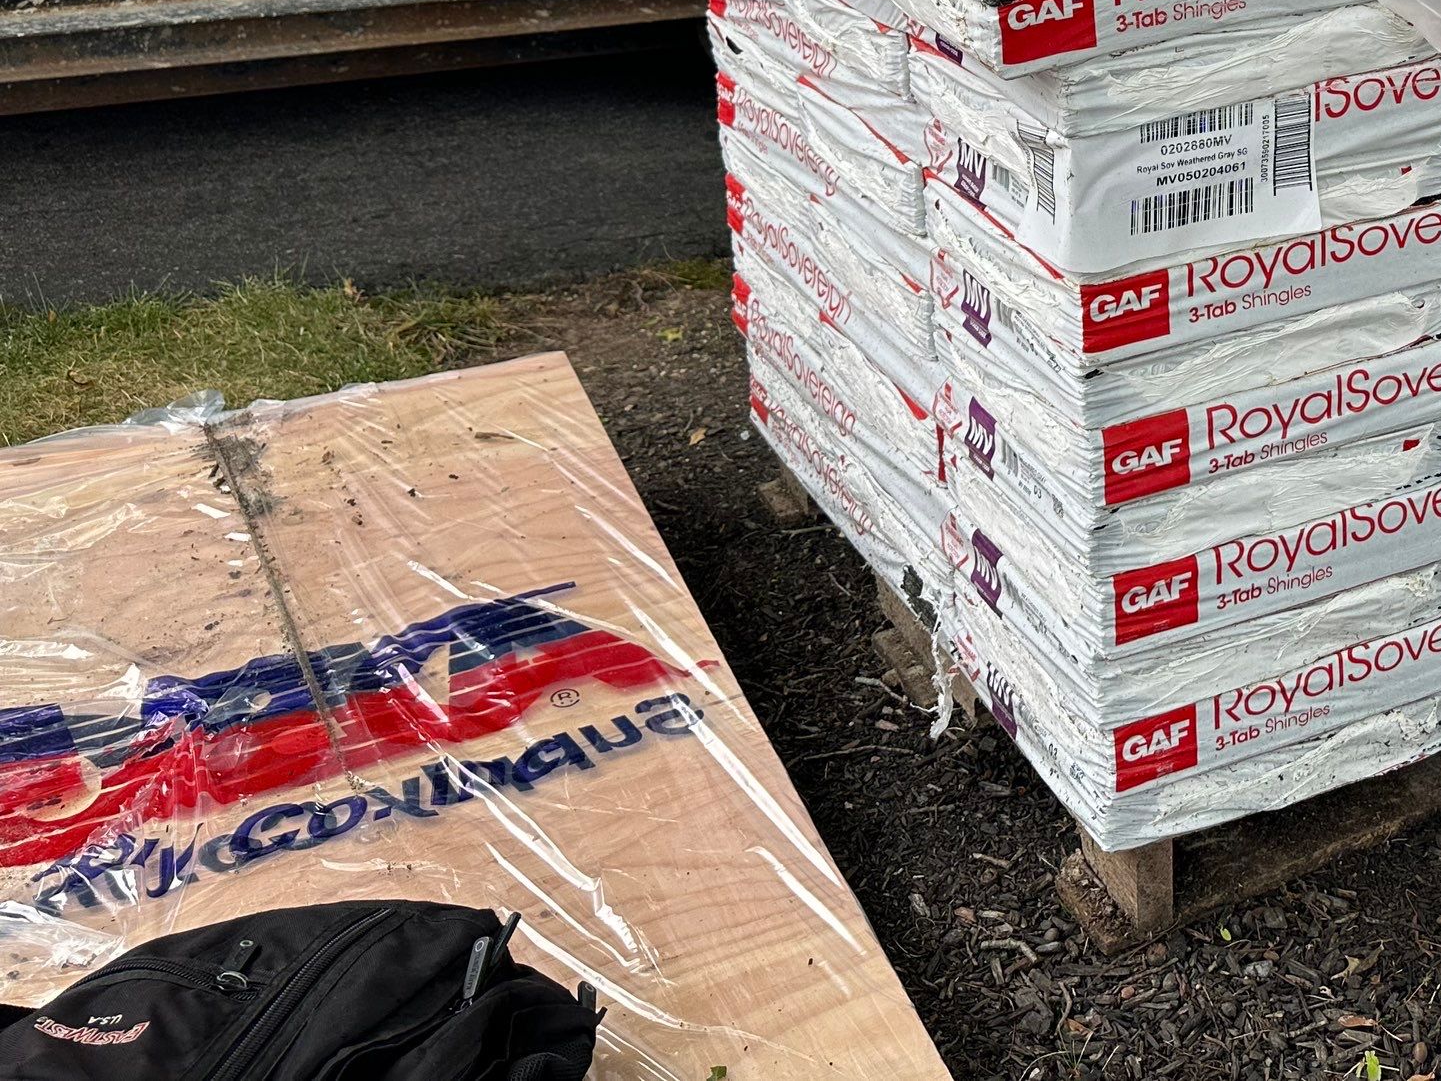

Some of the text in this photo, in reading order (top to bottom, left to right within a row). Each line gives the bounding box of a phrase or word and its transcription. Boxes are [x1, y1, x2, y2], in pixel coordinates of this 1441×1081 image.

[1116, 10, 1168, 34] 3-Tab
[959, 142, 986, 180] MV
[1137, 163, 1159, 175] Royal
[1160, 161, 1175, 171] Sov
[1177, 153, 1216, 167] Weathered
[1217, 149, 1236, 162] Gray
[1156, 161, 1246, 186] MV050204061
[964, 271, 991, 319] MV
[1090, 282, 1162, 322] GAF
[1188, 284, 1312, 324] 3-Tab Shingles
[968, 416, 994, 456] MV
[1111, 437, 1184, 474] GAF
[1208, 430, 1328, 475] 3-Tab Shingles
[1121, 577, 1192, 615] GAF
[1216, 564, 1334, 612] 3-Tab Shingles
[1121, 720, 1191, 762] GAF
[1215, 703, 1331, 752] 3-Tab Shingles
